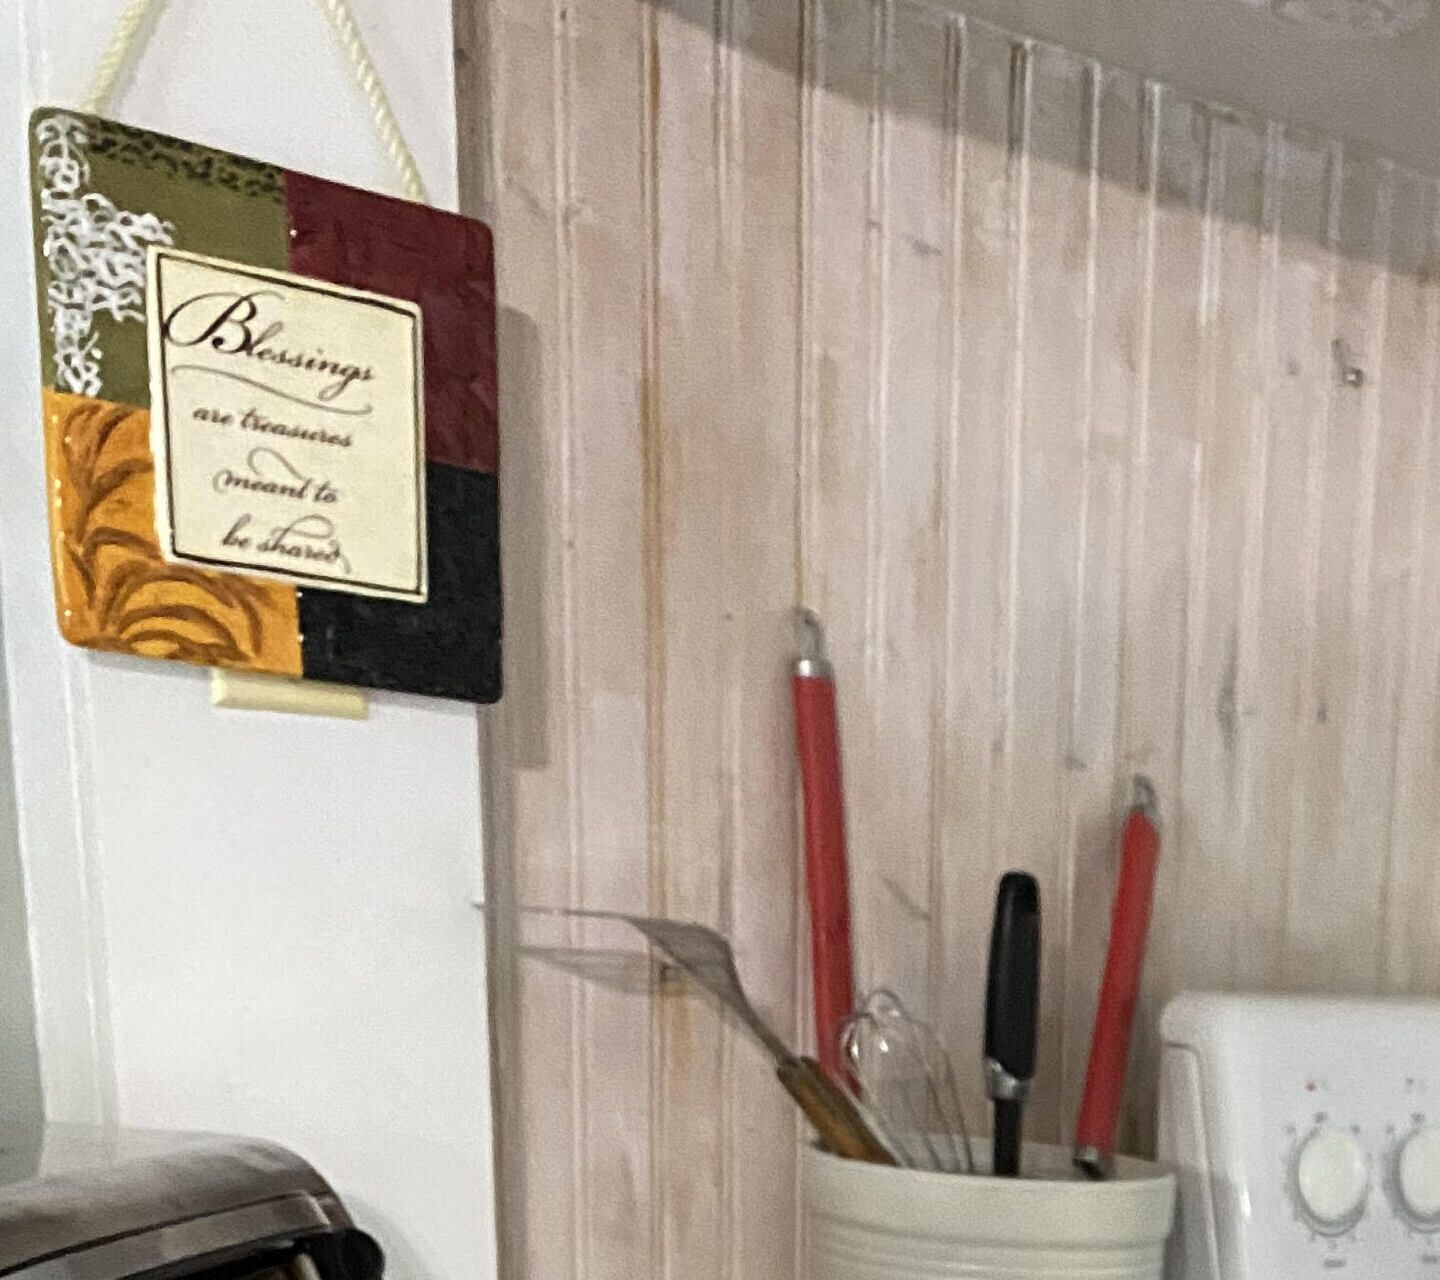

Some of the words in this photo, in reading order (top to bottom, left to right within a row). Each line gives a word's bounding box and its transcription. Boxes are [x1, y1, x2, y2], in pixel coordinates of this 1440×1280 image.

[162, 290, 373, 401] Blessings
[193, 407, 234, 425] are
[241, 407, 352, 447] treasures
[213, 447, 313, 499] meant
[314, 480, 338, 503] to
[222, 513, 251, 547] be
[256, 513, 351, 574] shared
